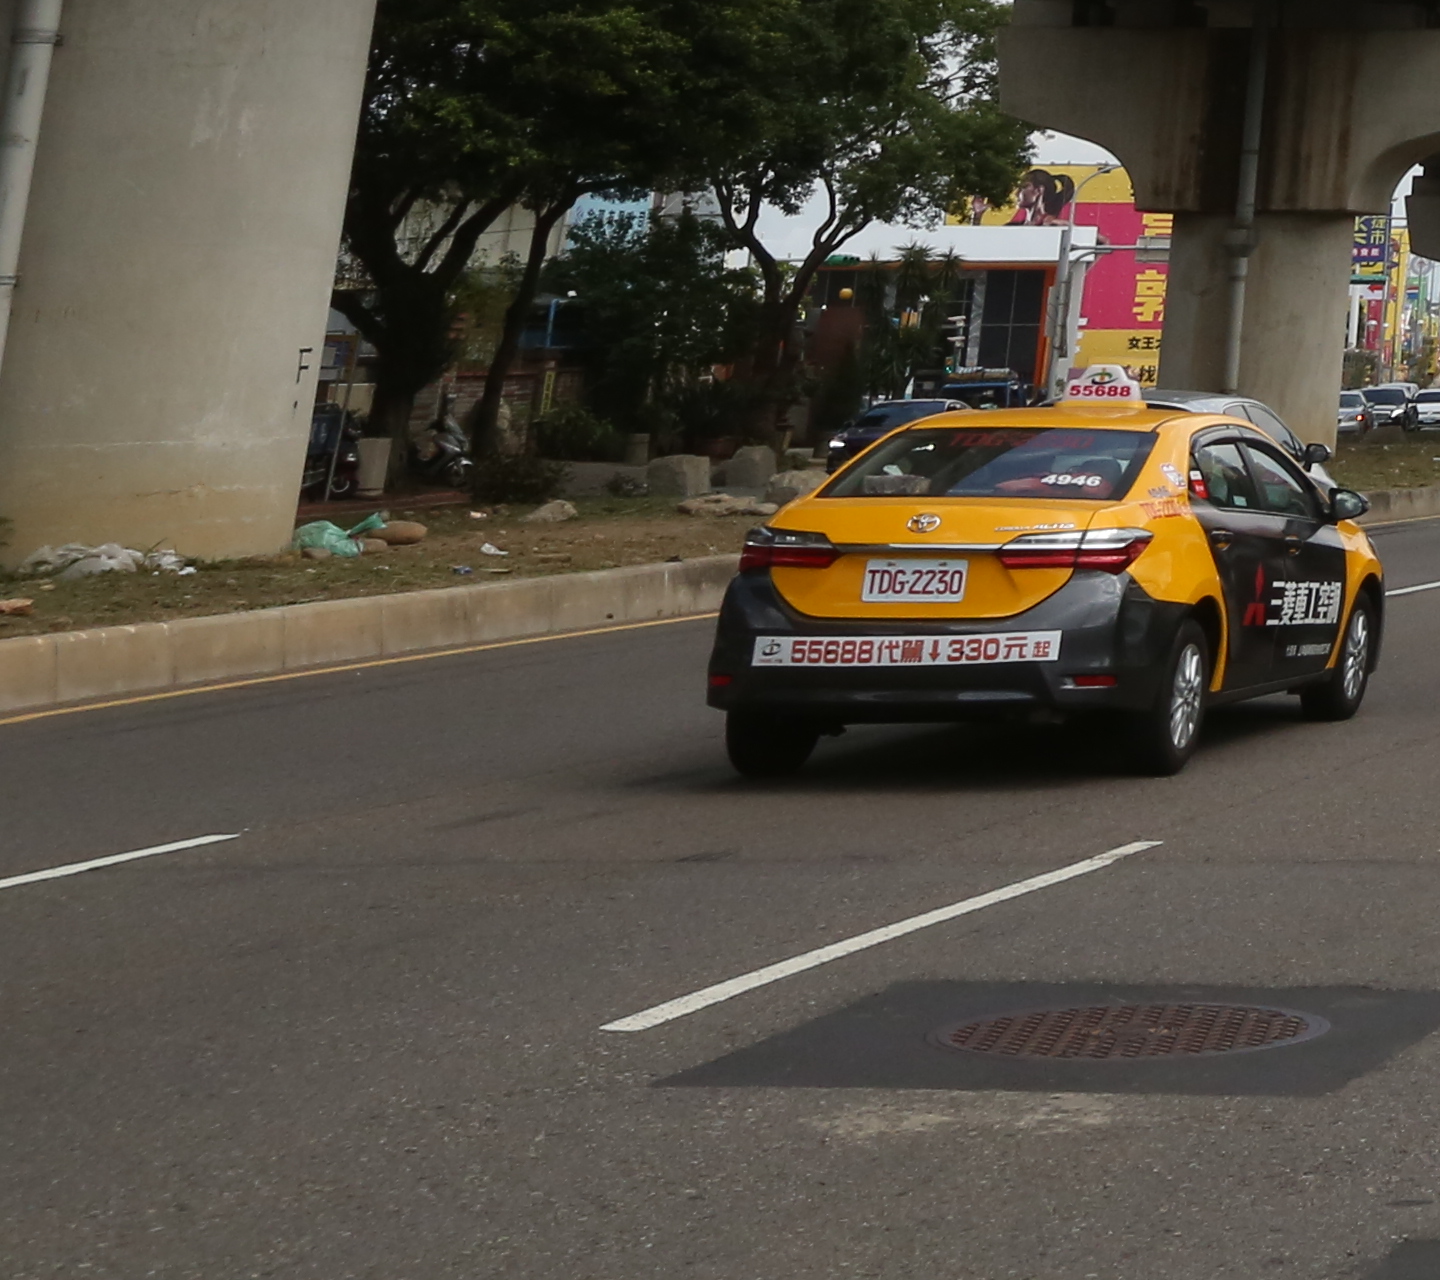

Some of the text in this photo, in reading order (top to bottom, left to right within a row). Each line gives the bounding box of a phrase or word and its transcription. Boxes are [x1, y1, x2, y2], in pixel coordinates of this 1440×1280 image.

[1069, 385, 1132, 397] 55688
[1040, 474, 1102, 487] 4946
[867, 569, 963, 595] TDG-2230
